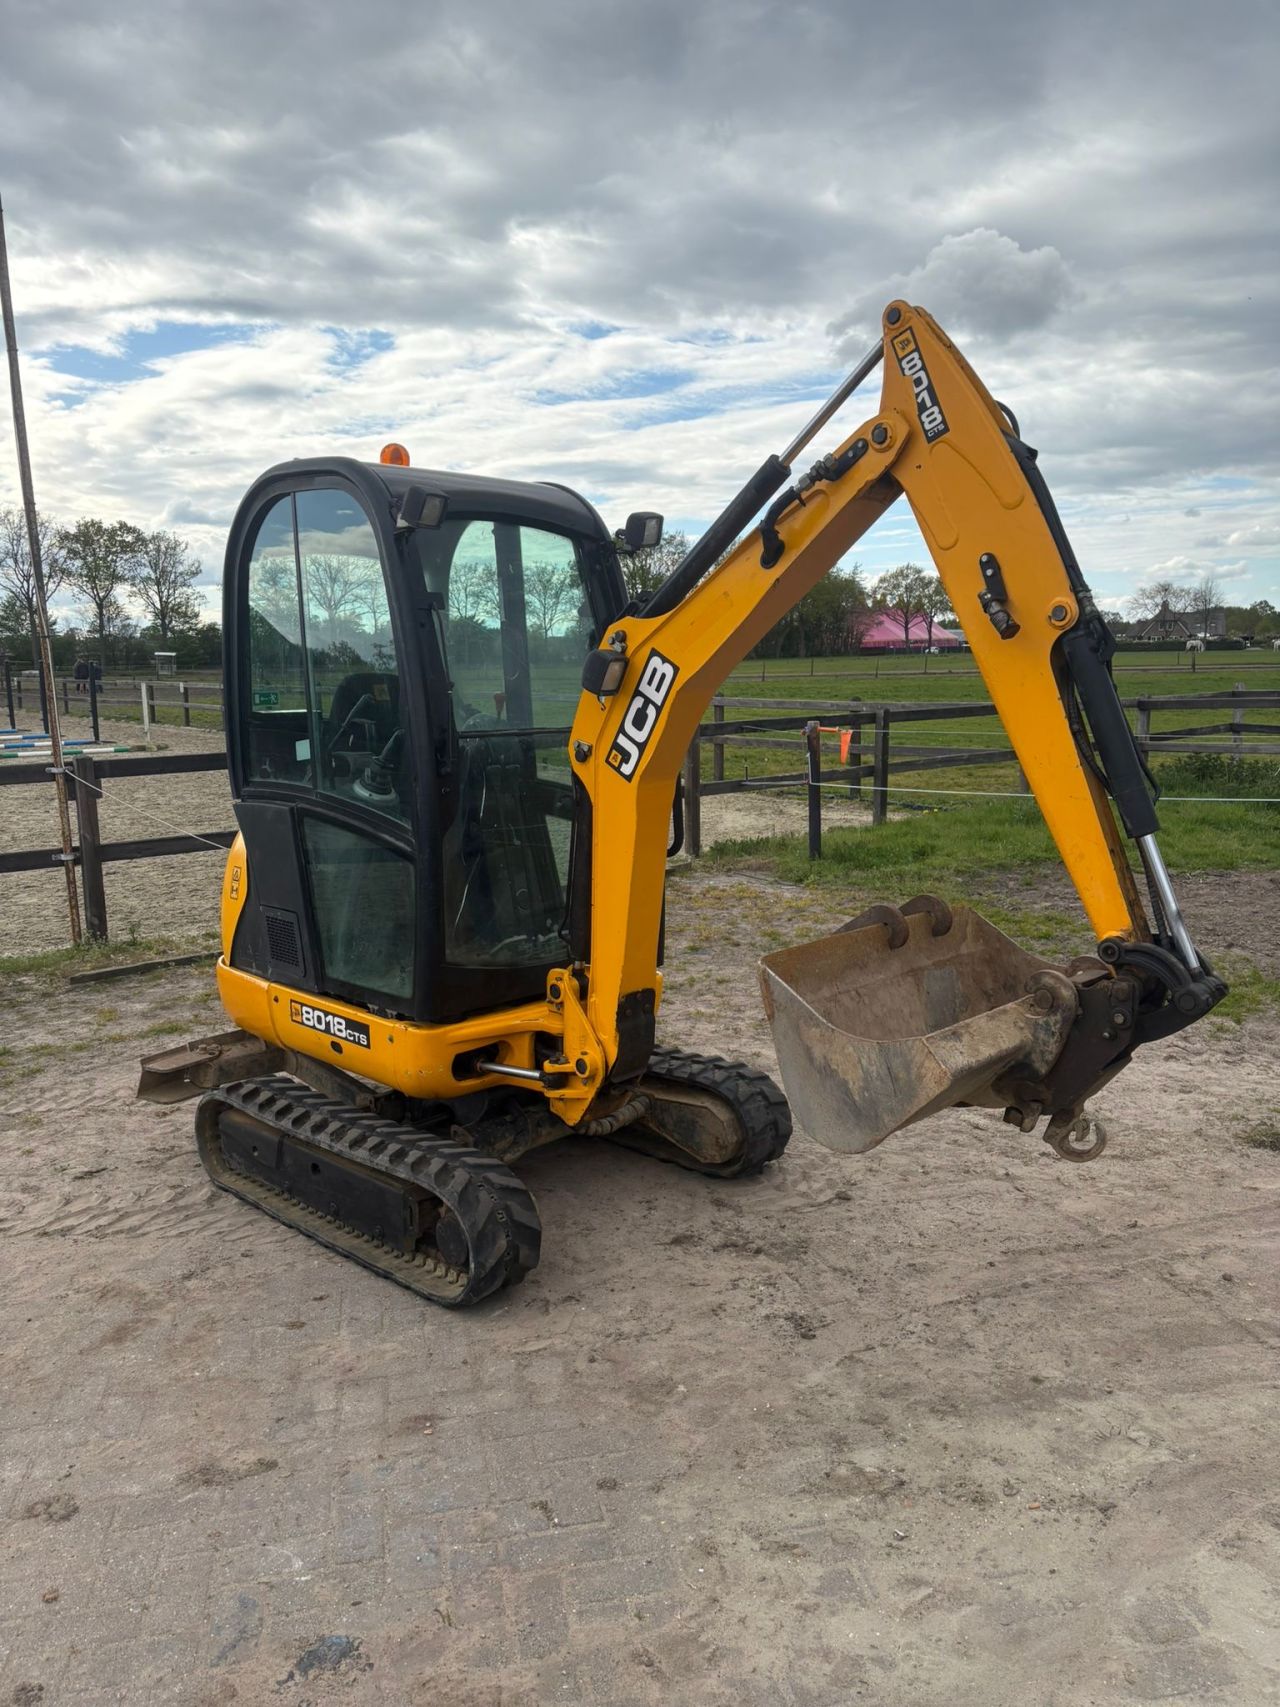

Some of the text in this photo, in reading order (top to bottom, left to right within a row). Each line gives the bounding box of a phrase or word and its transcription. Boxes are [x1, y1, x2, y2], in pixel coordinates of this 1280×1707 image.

[901, 351, 943, 431] 8018
[616, 655, 674, 776] JCB
[301, 1005, 368, 1046] 8018 CTS
